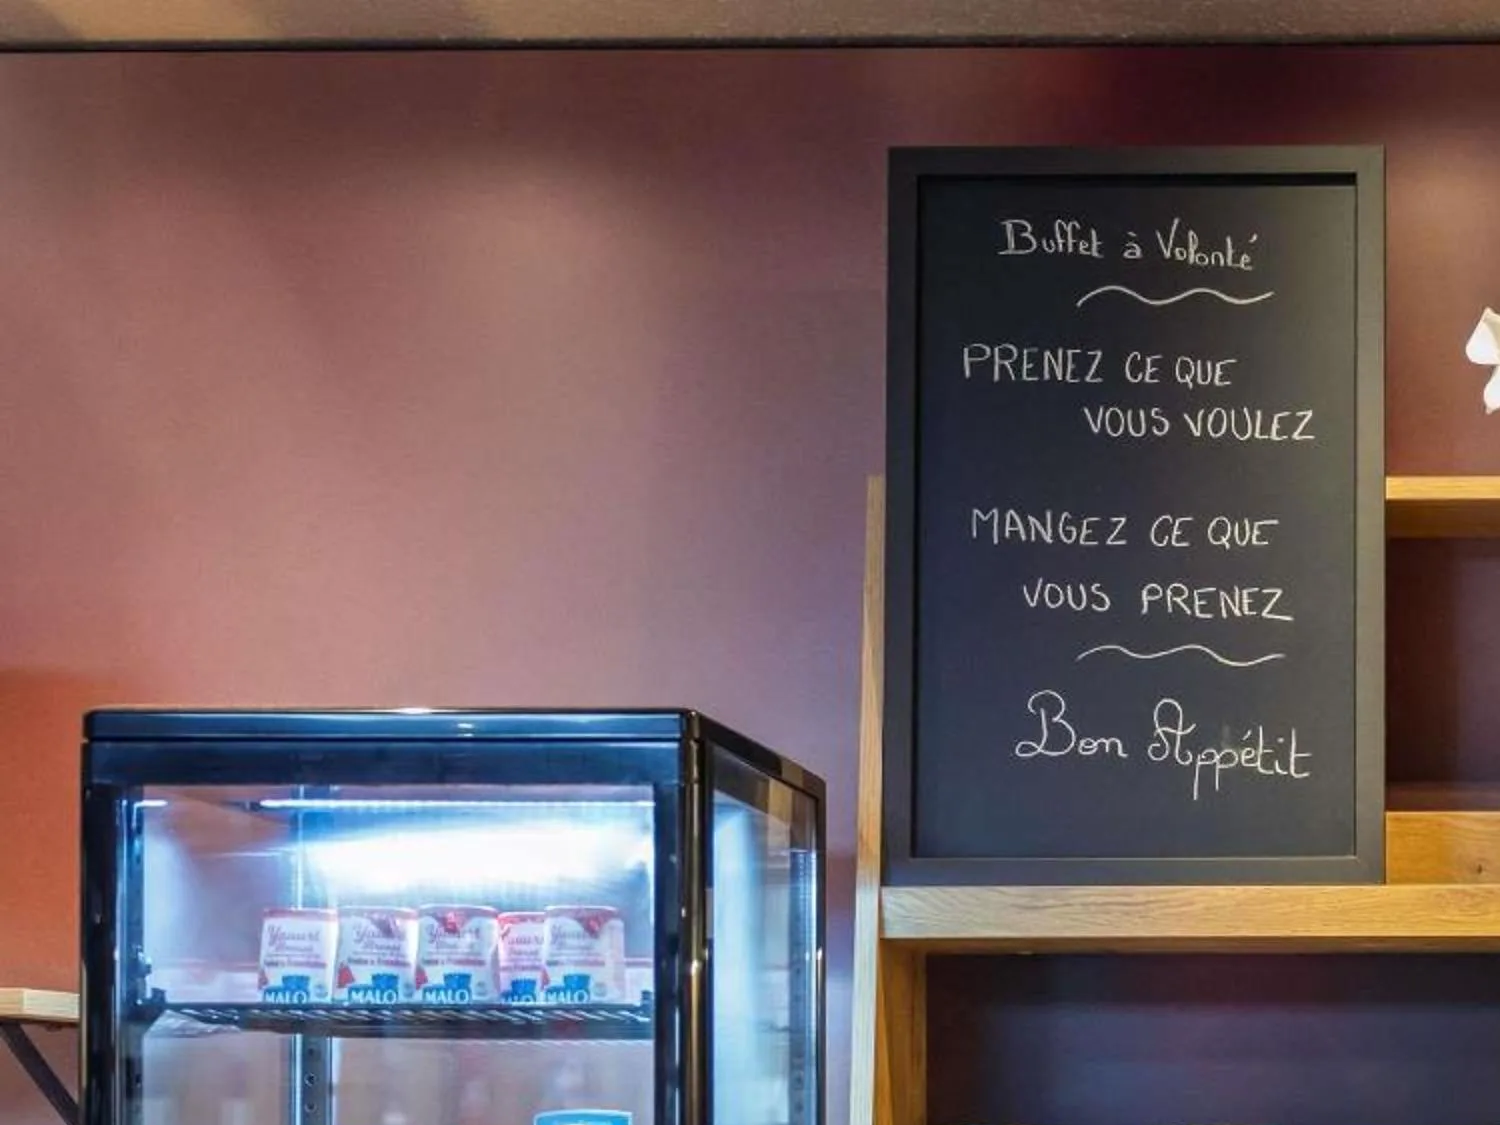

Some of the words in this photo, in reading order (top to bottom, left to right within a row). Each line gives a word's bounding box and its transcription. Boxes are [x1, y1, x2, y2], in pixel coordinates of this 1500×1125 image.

[998, 219, 1104, 258] Buffet
[1122, 233, 1142, 260] à
[1156, 218, 1258, 270] Volonté
[963, 343, 1103, 384] PRENEZ
[1125, 352, 1163, 385] CE
[1175, 355, 1238, 389] QUE
[1083, 406, 1170, 438] VOUS
[1183, 406, 1316, 441] VOULEZ
[971, 508, 1128, 547] MANGEZ
[1150, 515, 1193, 547] CE
[1207, 515, 1280, 550] QUE
[1023, 577, 1111, 613] VOUS
[1141, 583, 1295, 622] PRENEZ
[1014, 689, 1128, 757] Bon
[1147, 698, 1312, 800] Appétit
[264, 989, 309, 1004] MALO
[350, 988, 399, 1004] MALO
[424, 988, 470, 1004] MALO
[546, 989, 589, 1004] MALO
